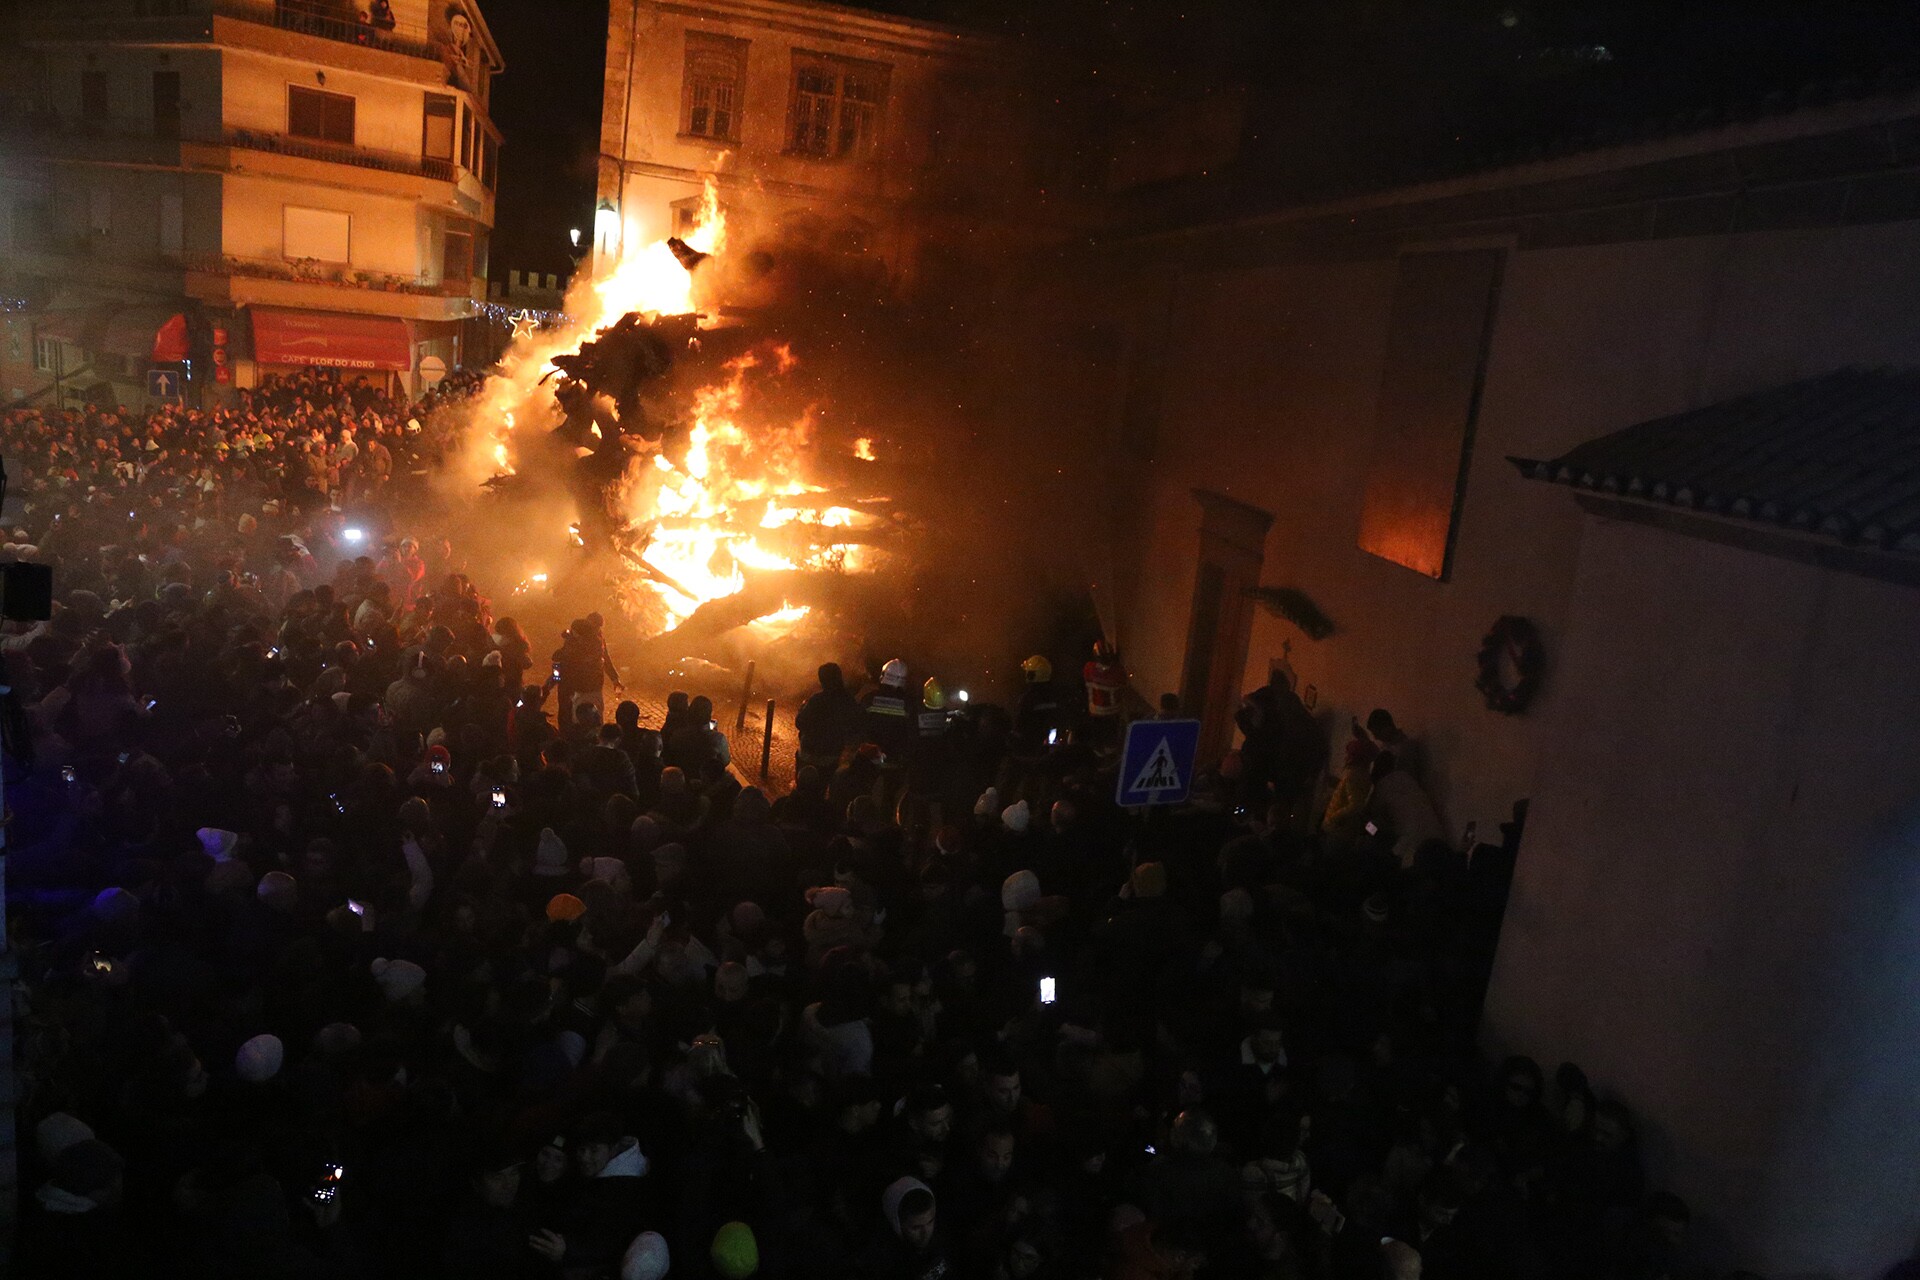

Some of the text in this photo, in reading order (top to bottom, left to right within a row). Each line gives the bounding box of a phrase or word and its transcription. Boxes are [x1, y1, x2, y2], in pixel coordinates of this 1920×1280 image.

[309, 356, 334, 366] FLOR
[335, 358, 348, 367] DO
[350, 359, 375, 369] ADRO
